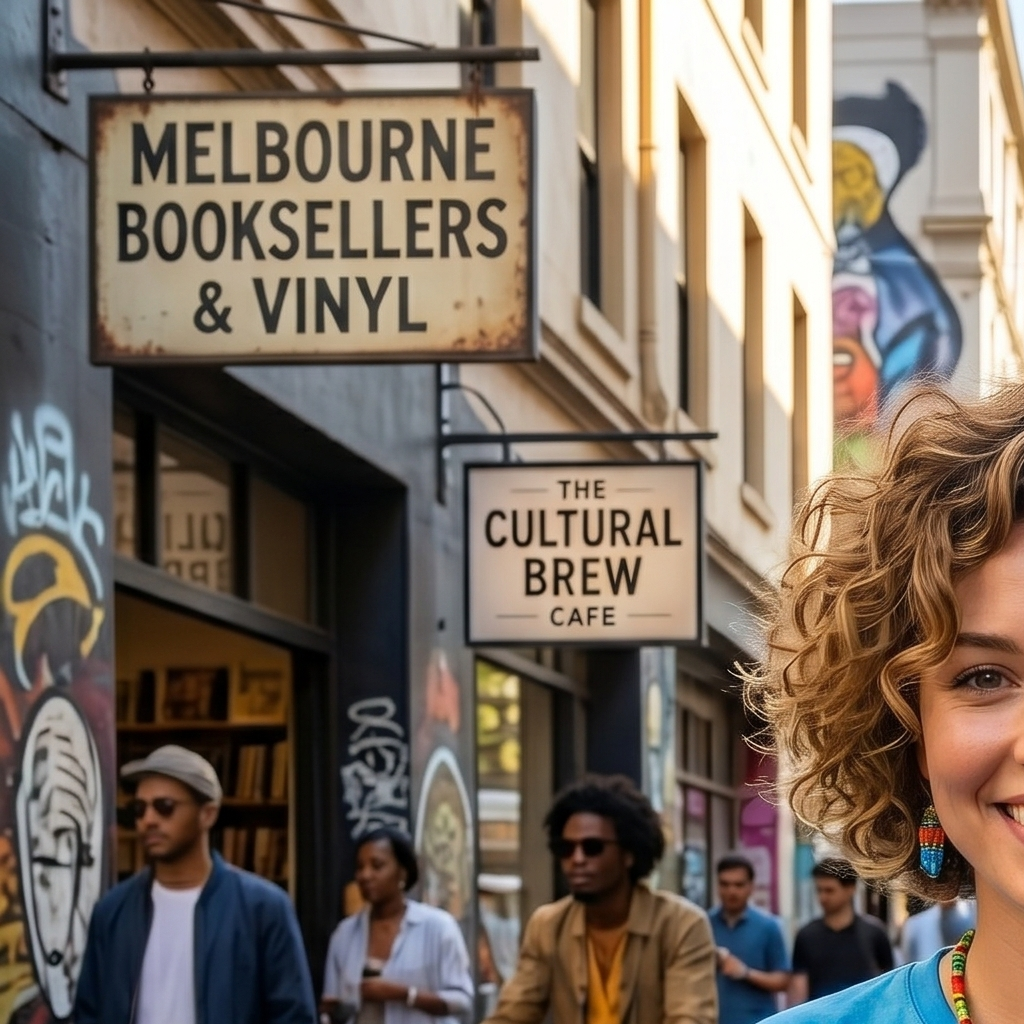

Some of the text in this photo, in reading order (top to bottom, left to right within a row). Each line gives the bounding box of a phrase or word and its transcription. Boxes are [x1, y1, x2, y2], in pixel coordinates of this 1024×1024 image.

[131, 118, 496, 186] MELBOURNE
[116, 199, 508, 263] BOOKSELLERS
[194, 277, 428, 334] & VINYL
[558, 480, 605, 500] THE
[484, 509, 682, 549] CULTURAL
[524, 557, 642, 597] BREW
[550, 607, 615, 627] CAFE
